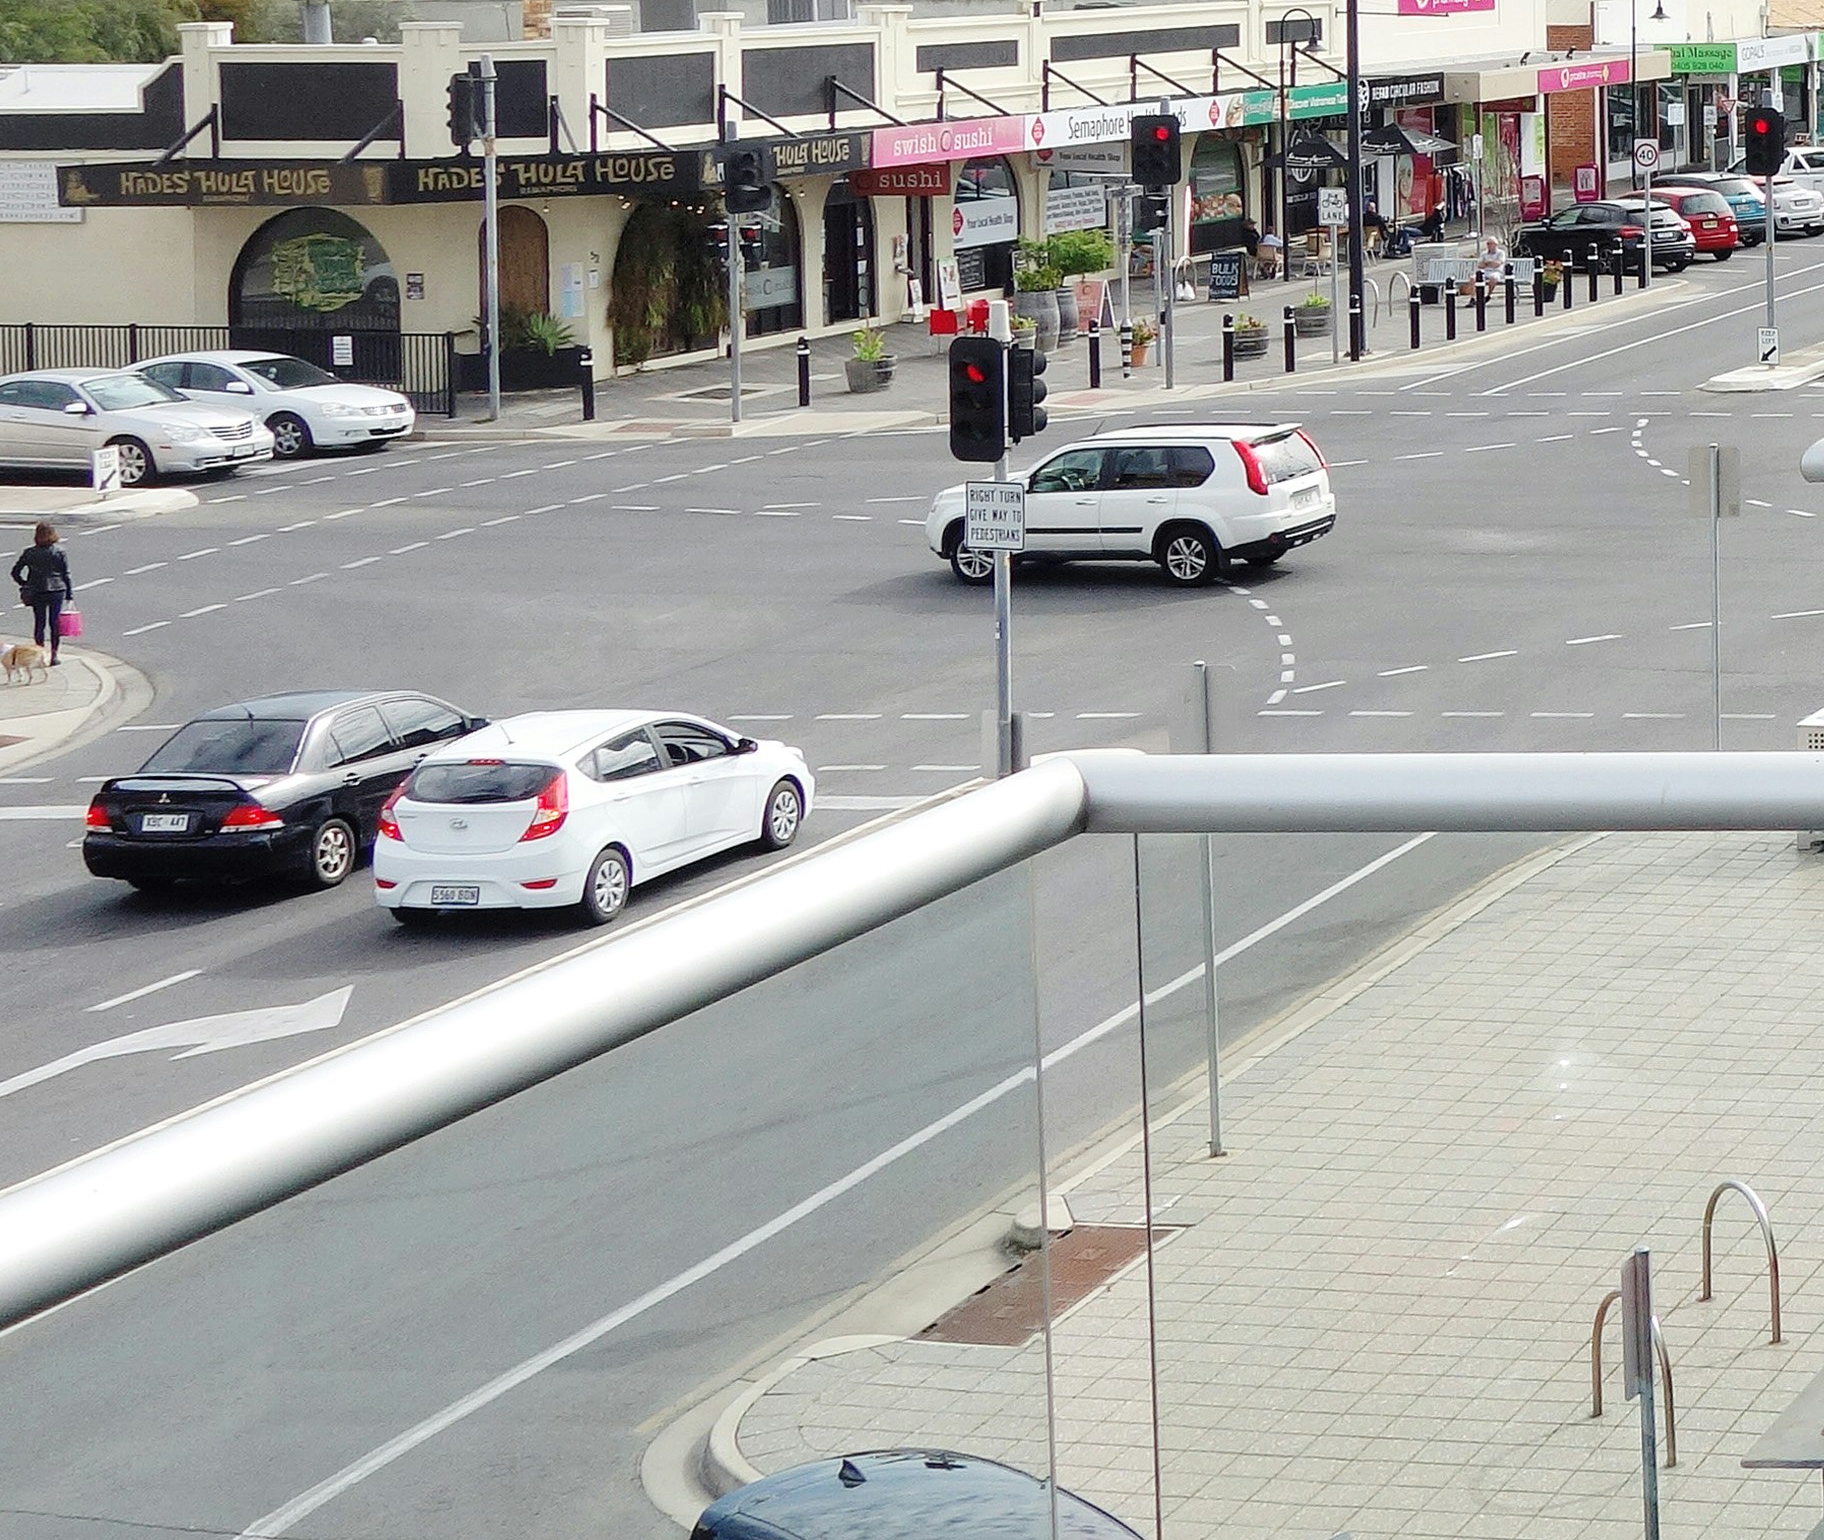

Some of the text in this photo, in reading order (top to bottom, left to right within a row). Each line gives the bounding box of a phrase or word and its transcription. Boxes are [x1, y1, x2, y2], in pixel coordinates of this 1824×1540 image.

[1068, 113, 1124, 141] Semaphore
[893, 127, 993, 156] swish sushi
[773, 142, 809, 168] HULA
[1639, 150, 1653, 160] 40
[193, 169, 256, 194] HULA
[510, 160, 586, 187] HULA
[878, 169, 943, 189] sushi
[1321, 212, 1344, 221] LANE
[1211, 262, 1239, 275] BULK
[970, 489, 1021, 503] RIGHT TURN
[970, 508, 1021, 523] GIVE WAY TO
[971, 527, 1020, 541] PEDESTRIANS
